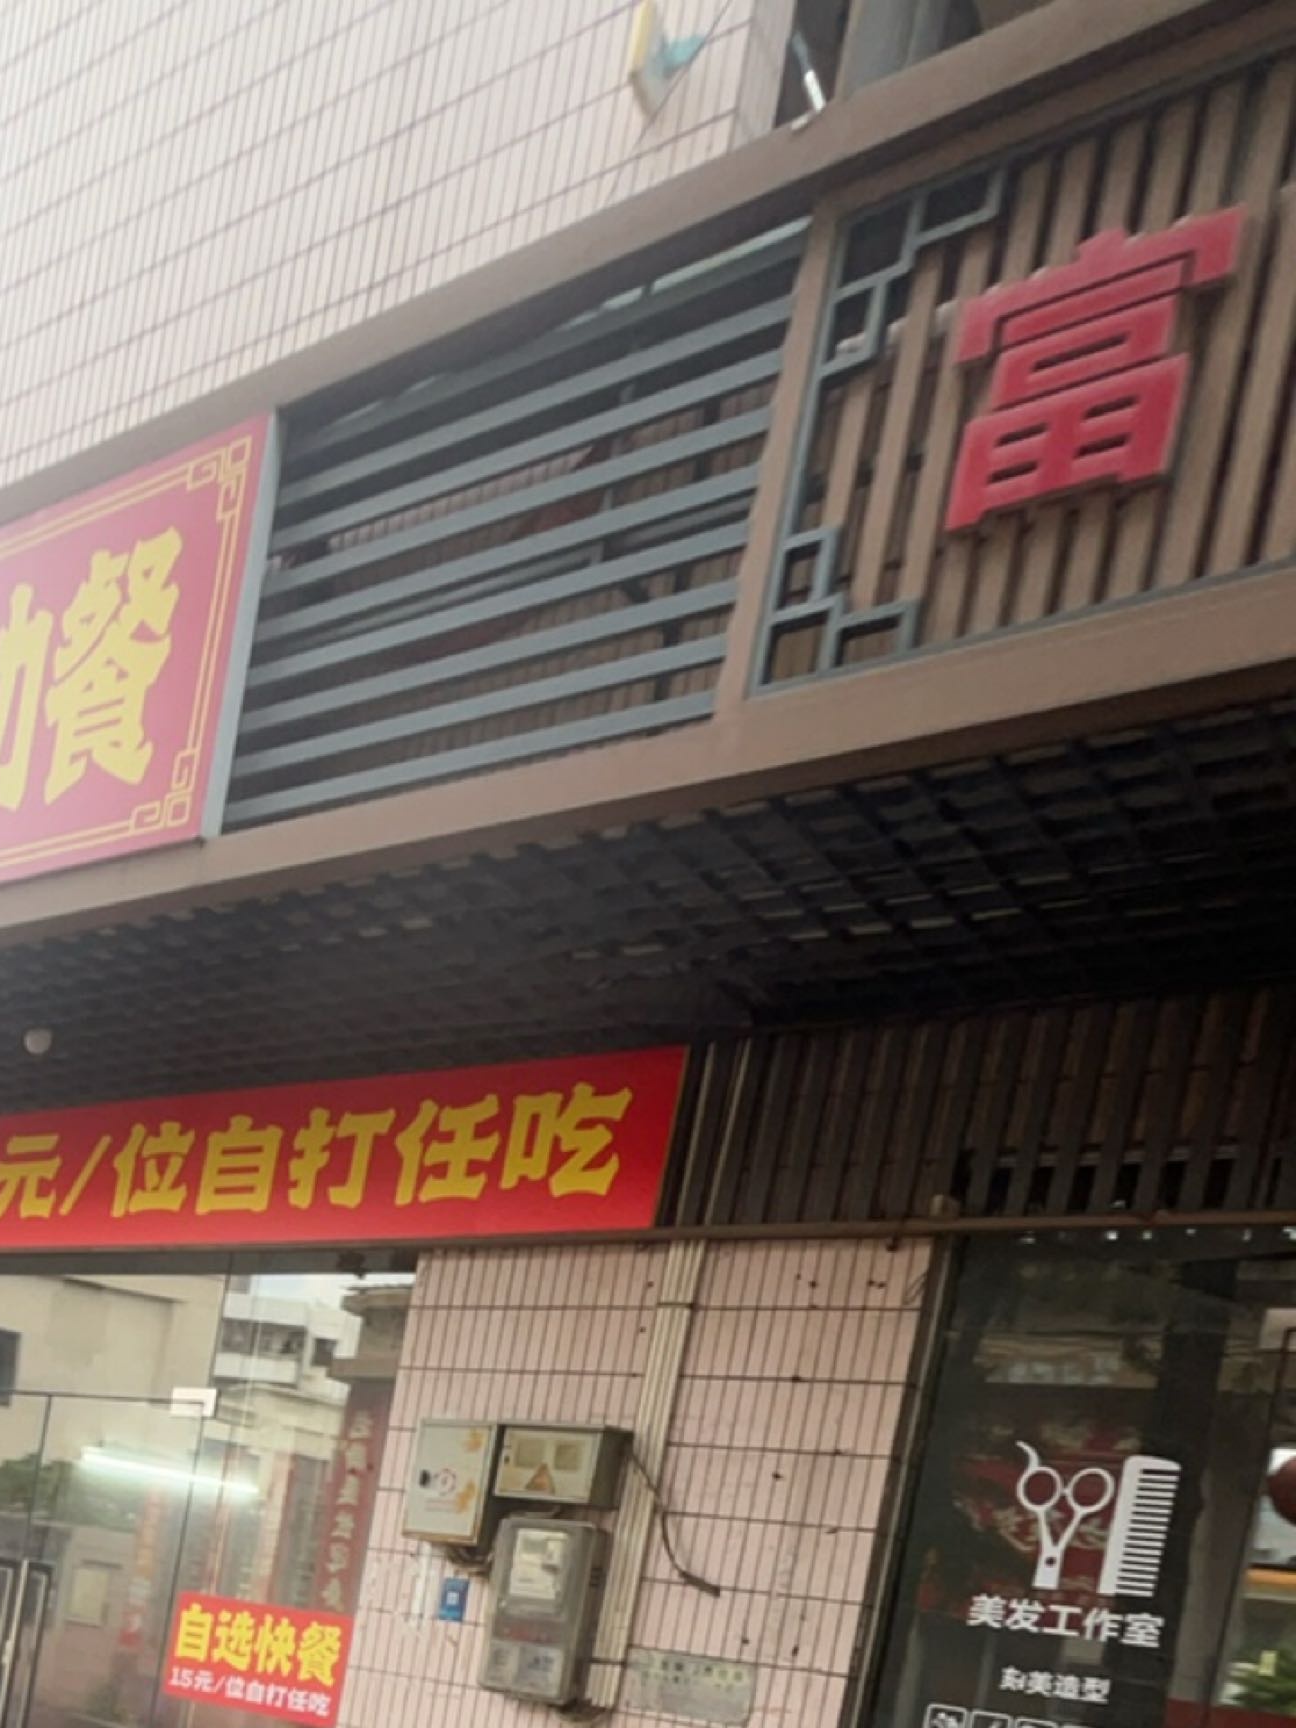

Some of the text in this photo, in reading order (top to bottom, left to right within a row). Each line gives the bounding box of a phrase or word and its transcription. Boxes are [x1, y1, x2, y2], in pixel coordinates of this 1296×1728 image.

[944, 205, 1248, 531] 富
[175, 1603, 341, 1687] 自选快餐
[966, 1593, 1165, 1648] 美发工作室
